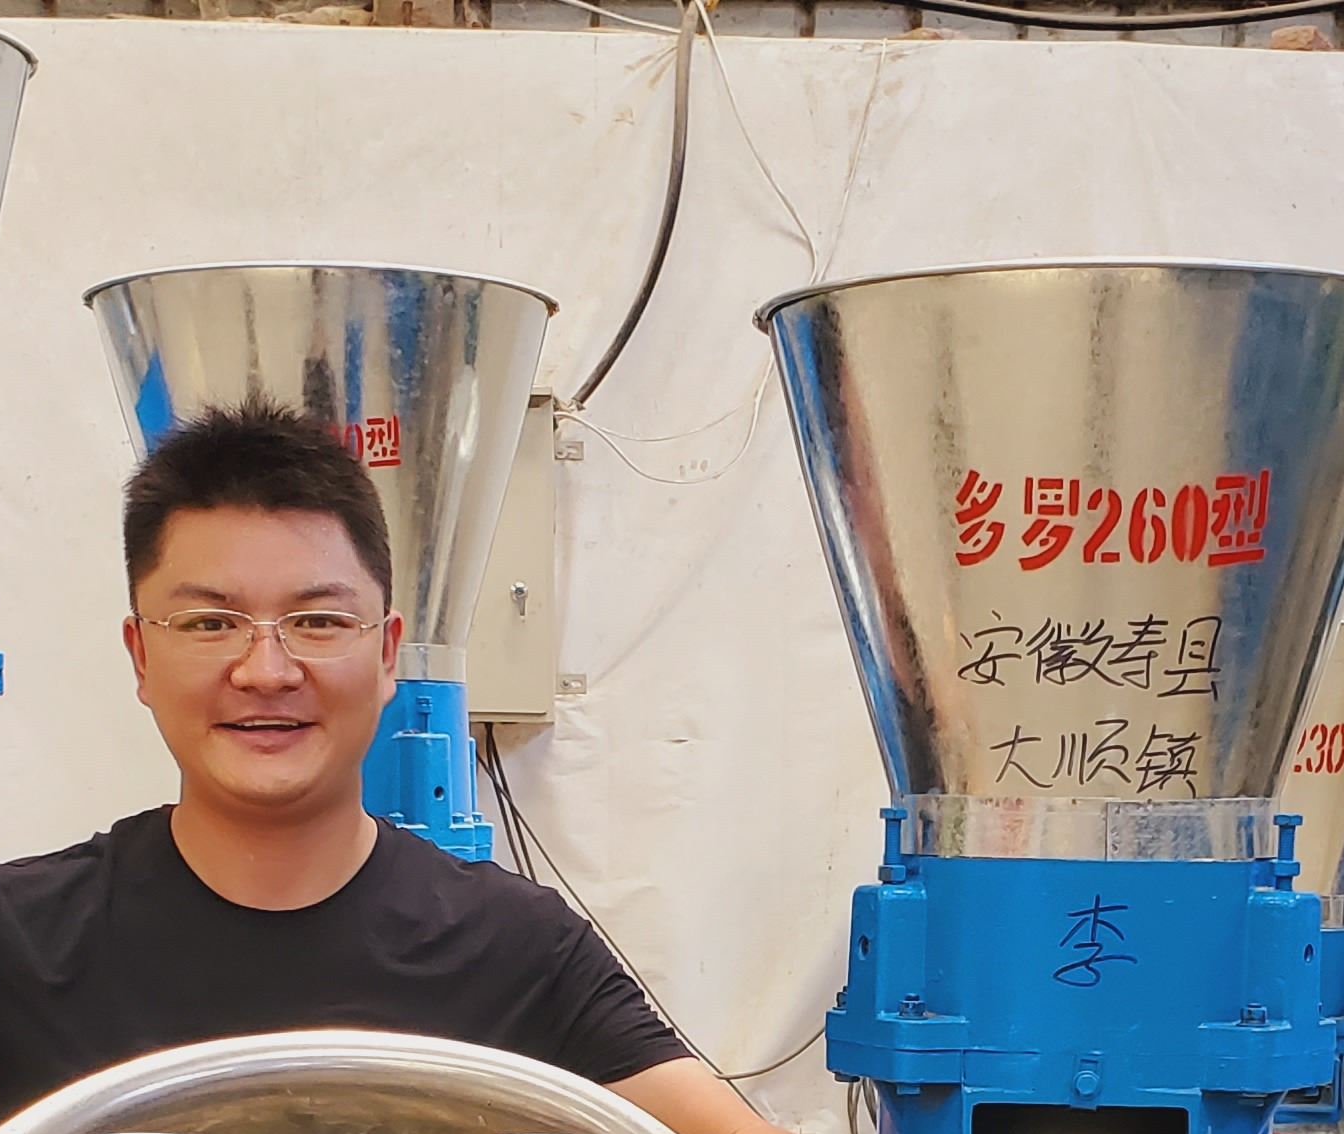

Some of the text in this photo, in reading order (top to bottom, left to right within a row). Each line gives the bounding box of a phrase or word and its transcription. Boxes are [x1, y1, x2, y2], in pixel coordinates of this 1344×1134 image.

[330, 414, 401, 468] 0型
[954, 469, 1271, 571] 多罗260型
[957, 610, 1223, 701] 安徽寿县
[989, 718, 1203, 799] 大顺镇
[1052, 894, 1138, 987] 李
